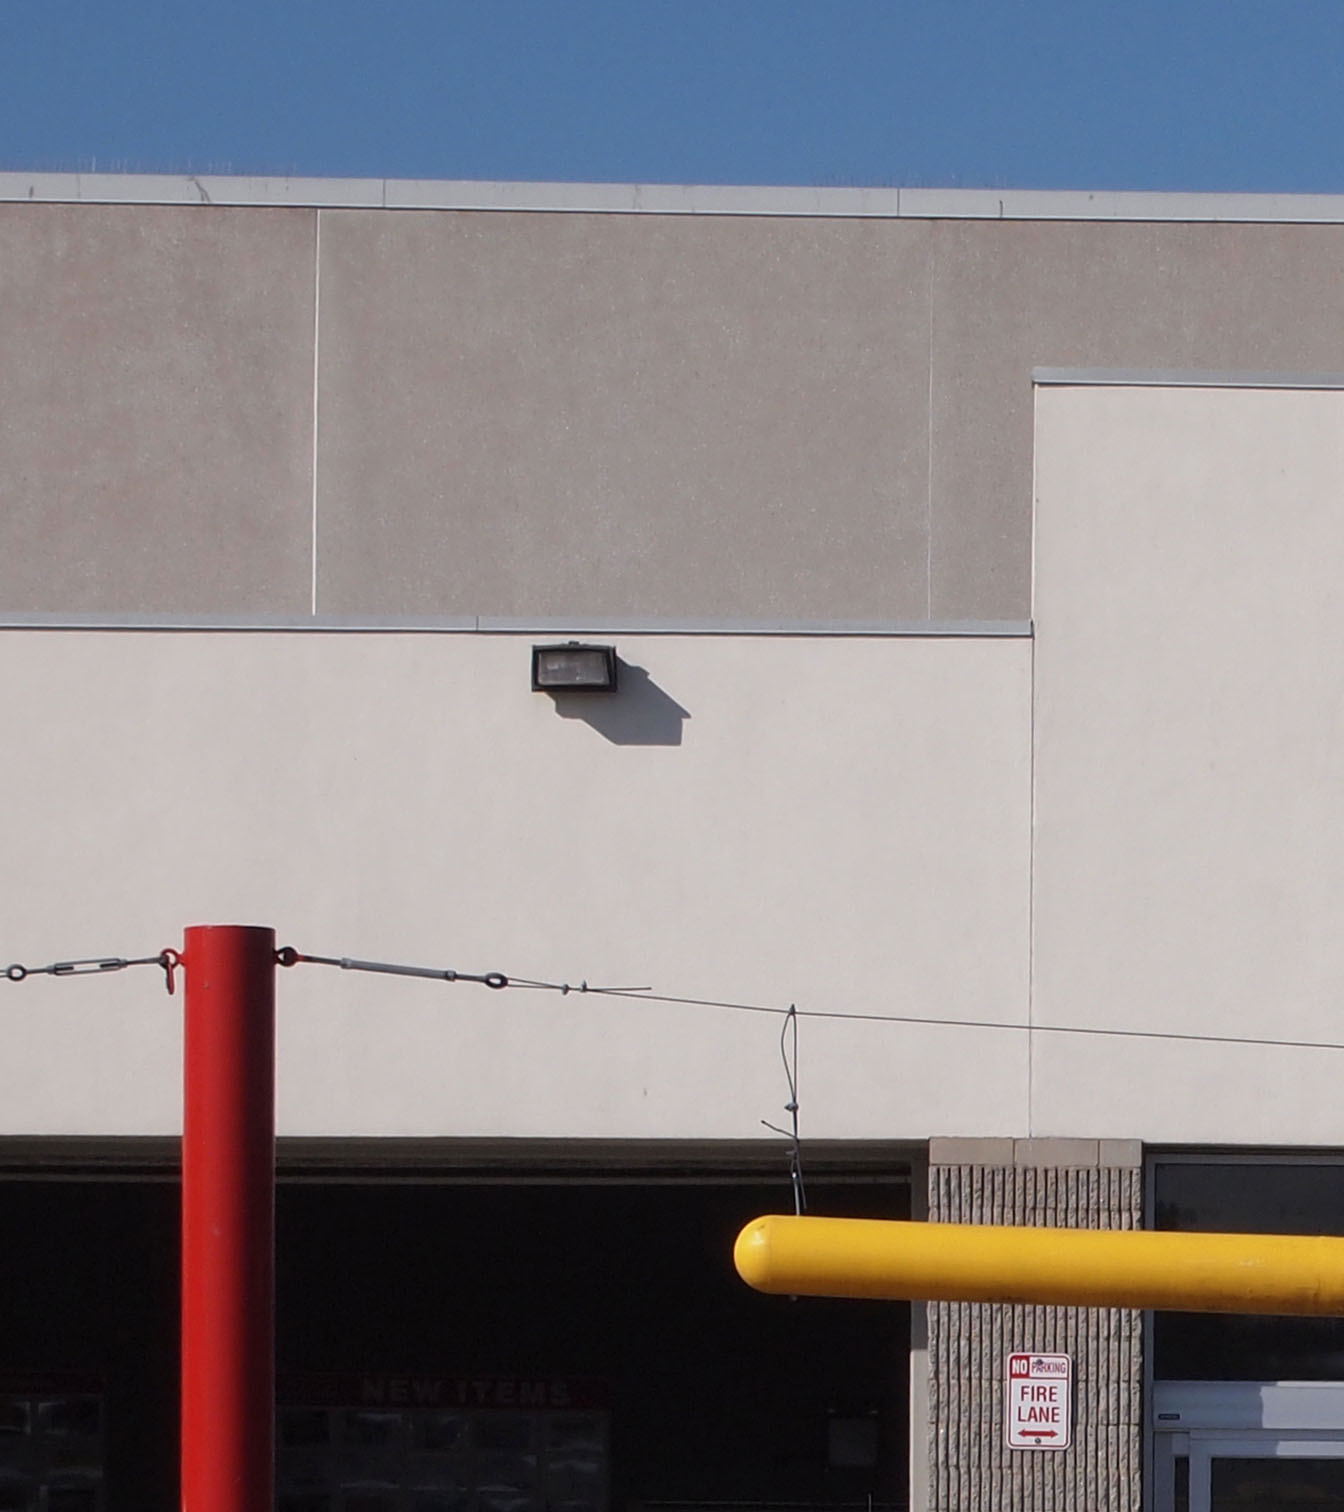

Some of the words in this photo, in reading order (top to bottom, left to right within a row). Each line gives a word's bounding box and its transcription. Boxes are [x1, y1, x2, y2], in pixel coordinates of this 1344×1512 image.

[1012, 1359, 1028, 1374] NO
[1031, 1361, 1066, 1374] PARKING
[363, 1379, 442, 1402] NEW
[454, 1380, 570, 1404] ITEMS
[1020, 1385, 1058, 1402] FIRE
[1017, 1405, 1060, 1423] LANE
